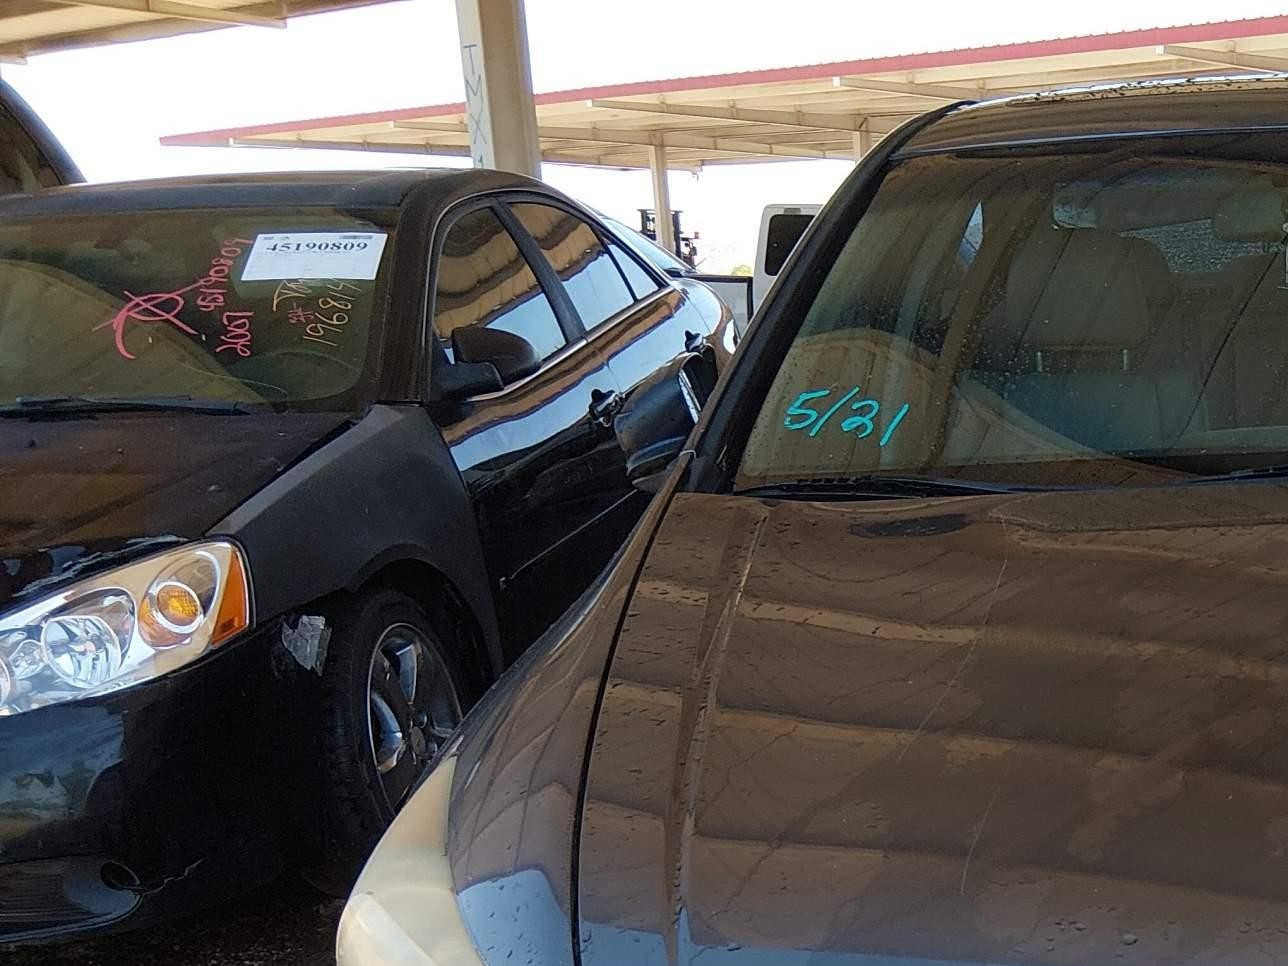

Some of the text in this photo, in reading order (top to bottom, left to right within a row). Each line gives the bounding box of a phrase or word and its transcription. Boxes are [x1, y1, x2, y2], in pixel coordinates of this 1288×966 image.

[265, 241, 369, 252] 45190809
[215, 310, 256, 358] 2007
[783, 386, 911, 447] 5/21
